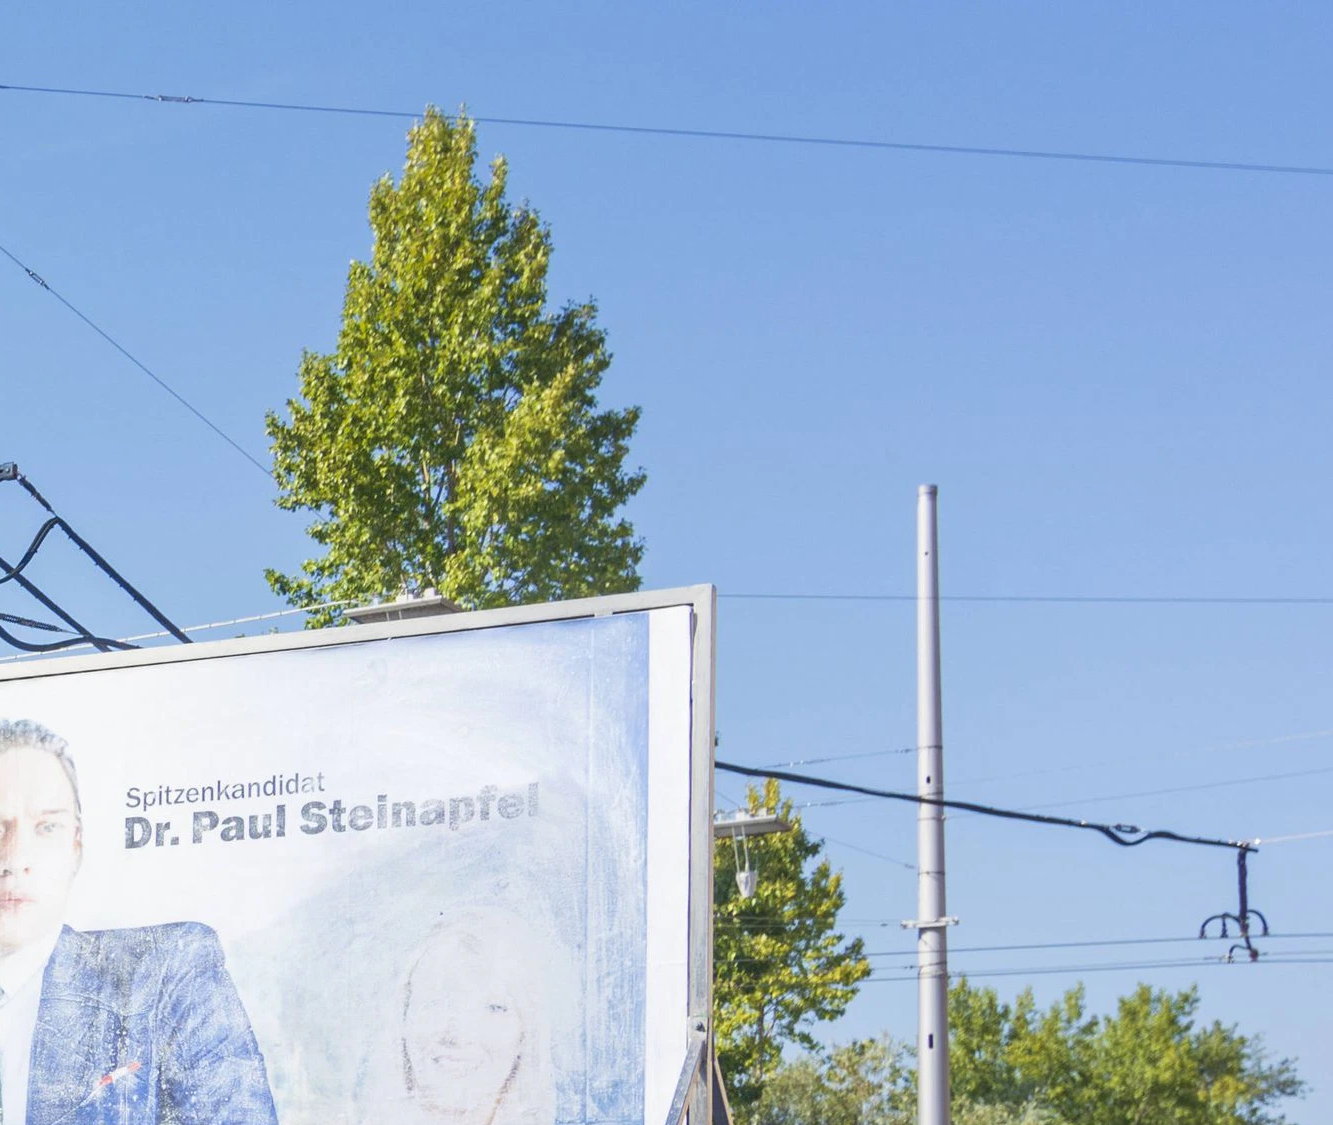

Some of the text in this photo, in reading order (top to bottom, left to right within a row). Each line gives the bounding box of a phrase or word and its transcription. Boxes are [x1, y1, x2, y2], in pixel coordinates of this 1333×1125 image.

[125, 782, 539, 849] Dr. Paul Steinapfel
[126, 772, 325, 811] Spitzenkandidat
